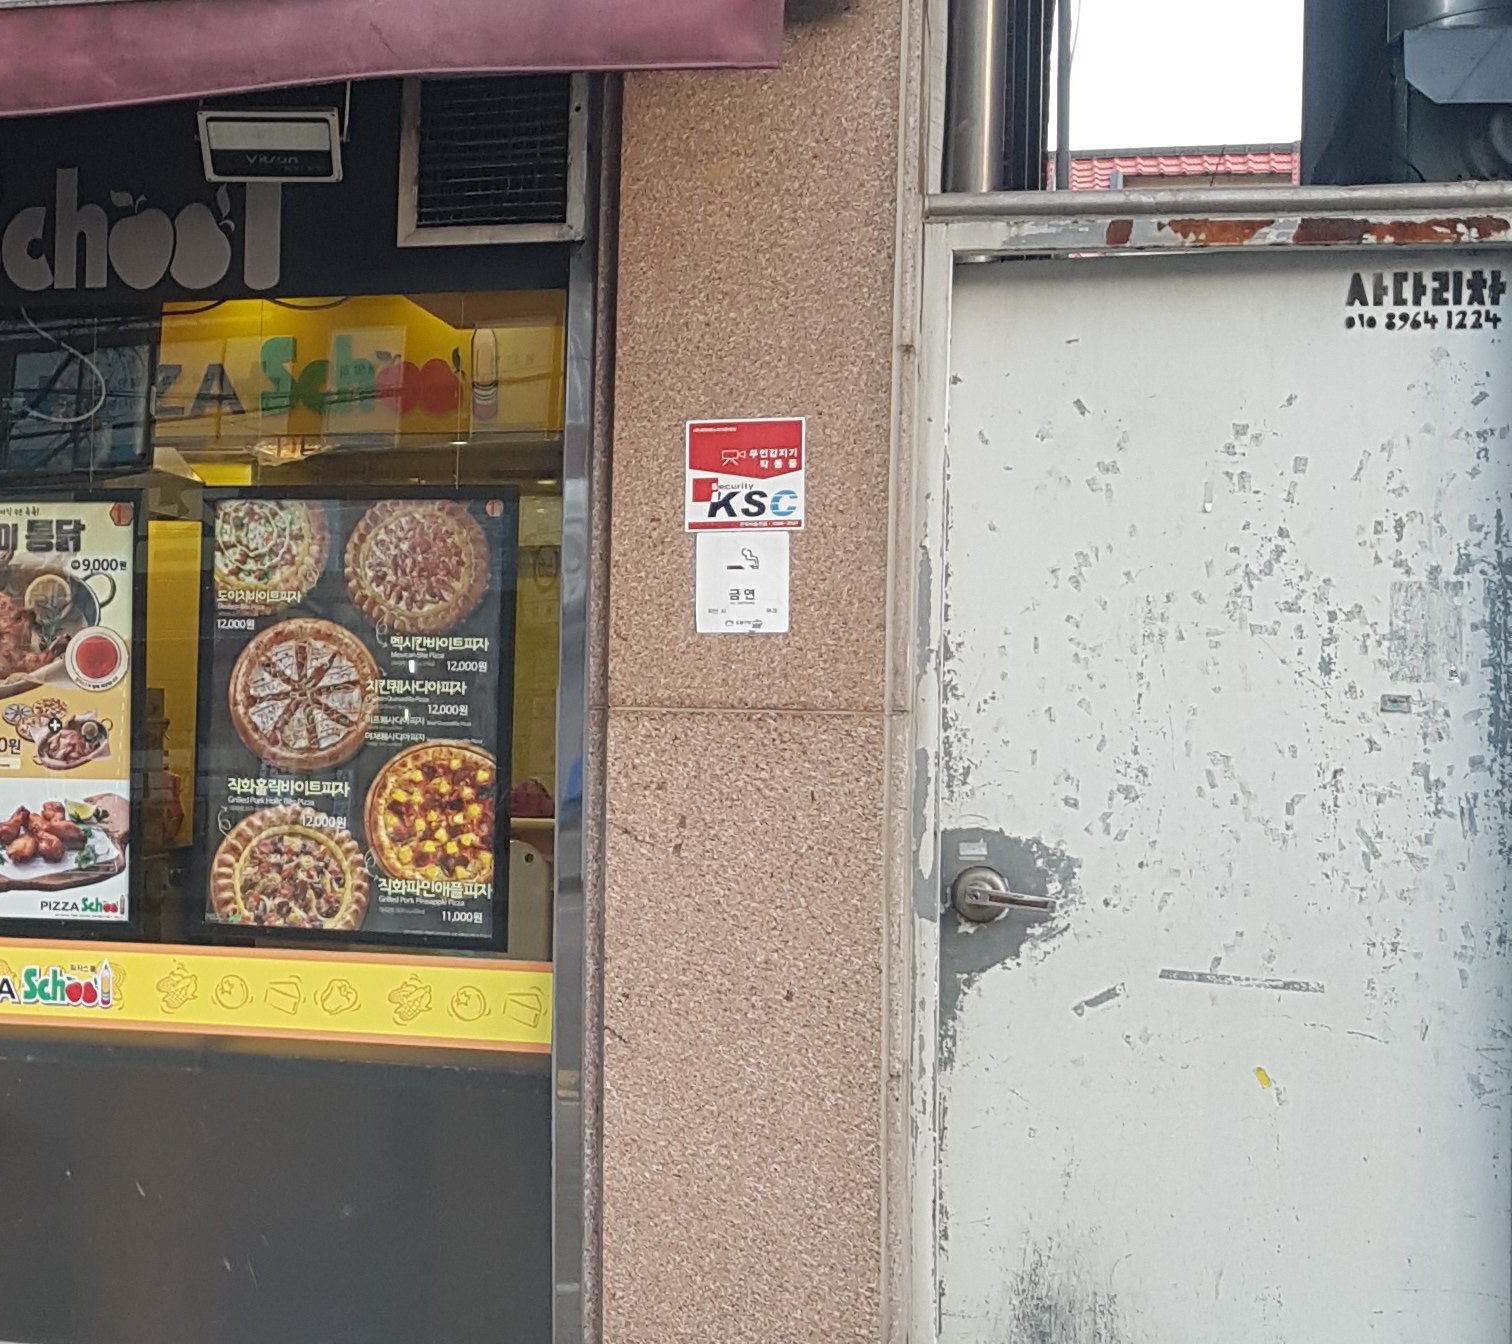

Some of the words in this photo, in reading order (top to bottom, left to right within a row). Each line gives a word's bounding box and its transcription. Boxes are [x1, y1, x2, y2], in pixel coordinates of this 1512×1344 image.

[1345, 270, 1508, 307] 사다리차
[1345, 312, 1377, 329] 010
[1385, 311, 1438, 330] 8964
[1446, 309, 1502, 330] 1224
[707, 489, 798, 518] KSC
[390, 636, 490, 652] 멕시칸바이트피자
[378, 878, 494, 900] 직화파인애플피자
[40, 901, 80, 912] PIZZA
[81, 894, 125, 915] School
[441, 910, 483, 924] 11,000원
[22, 959, 114, 1008] School
